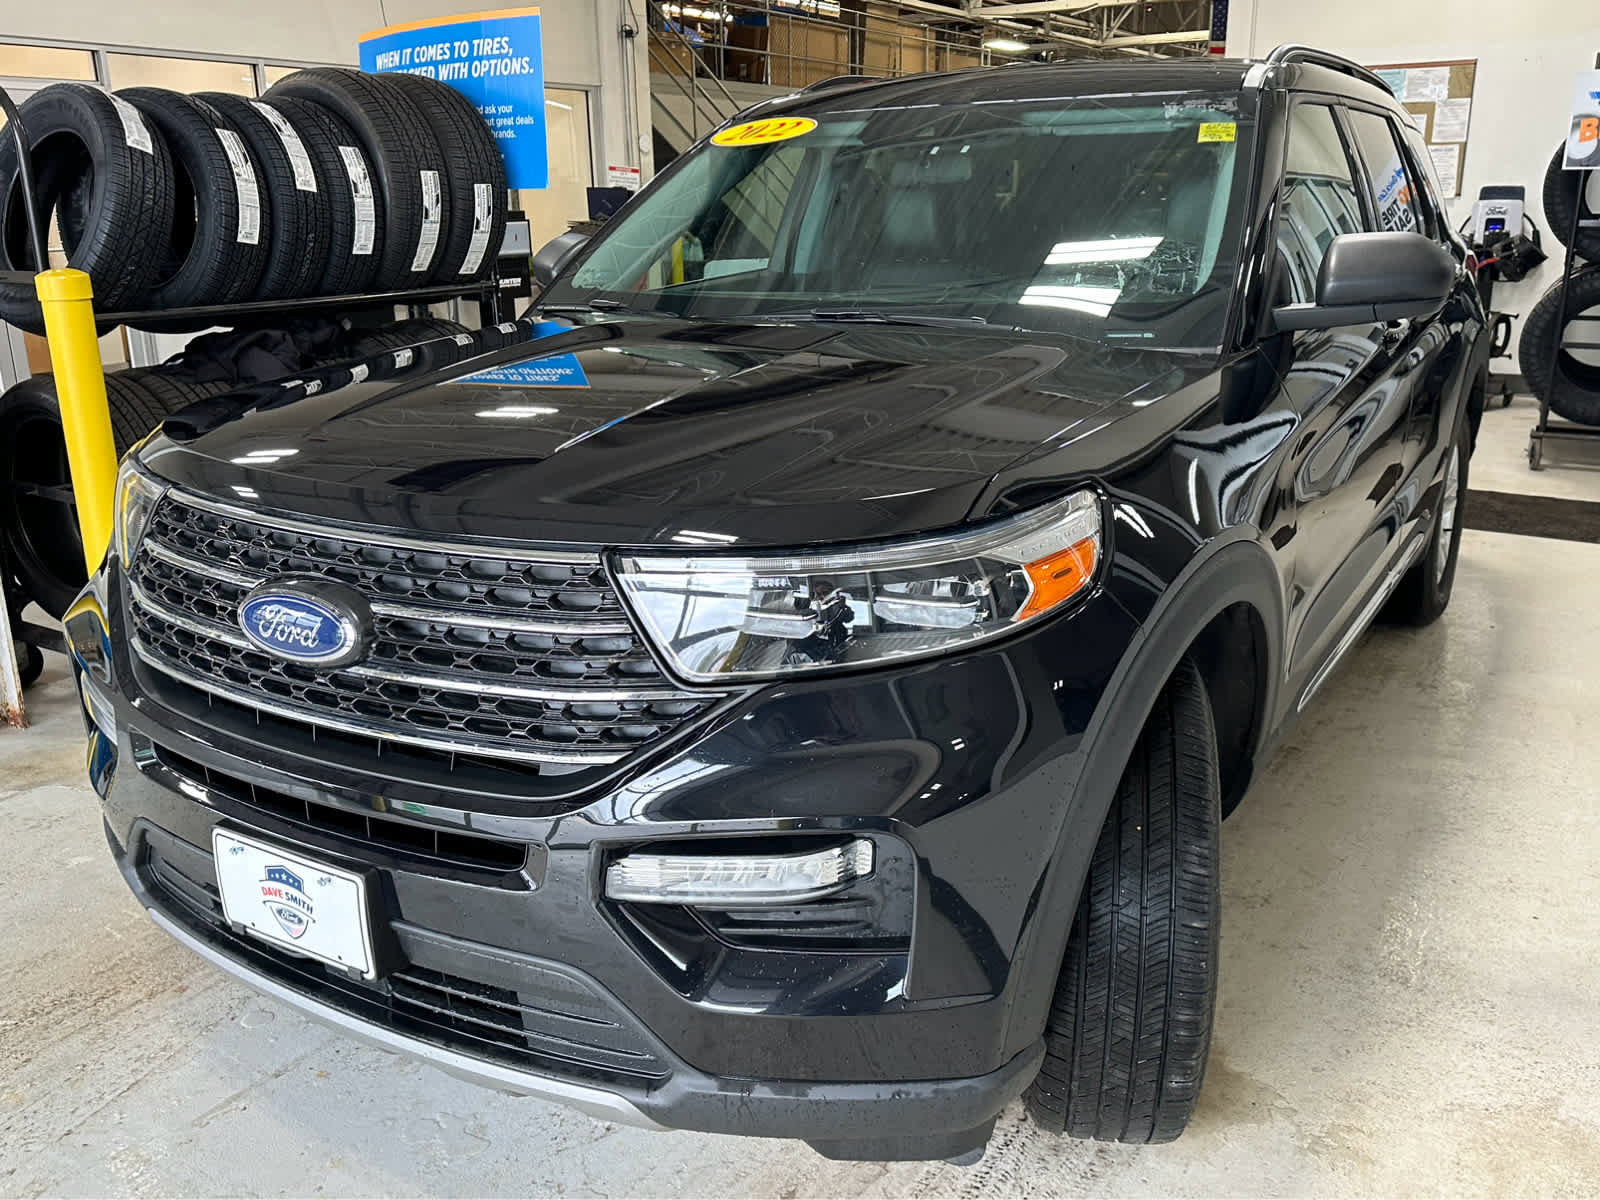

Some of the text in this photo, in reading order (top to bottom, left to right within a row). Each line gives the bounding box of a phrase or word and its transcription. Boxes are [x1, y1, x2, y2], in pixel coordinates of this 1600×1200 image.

[376, 36, 513, 71] WHEN IT COMES TO TIRES,
[438, 63, 468, 81] WITH
[471, 57, 534, 78] OPTIONS.
[484, 104, 497, 114] ask
[497, 105, 513, 116] your
[496, 116, 515, 128] great
[516, 115, 534, 126] deals
[721, 121, 803, 142] 2022
[256, 604, 322, 649] Ford
[261, 886, 313, 915] DAVE SMITH
